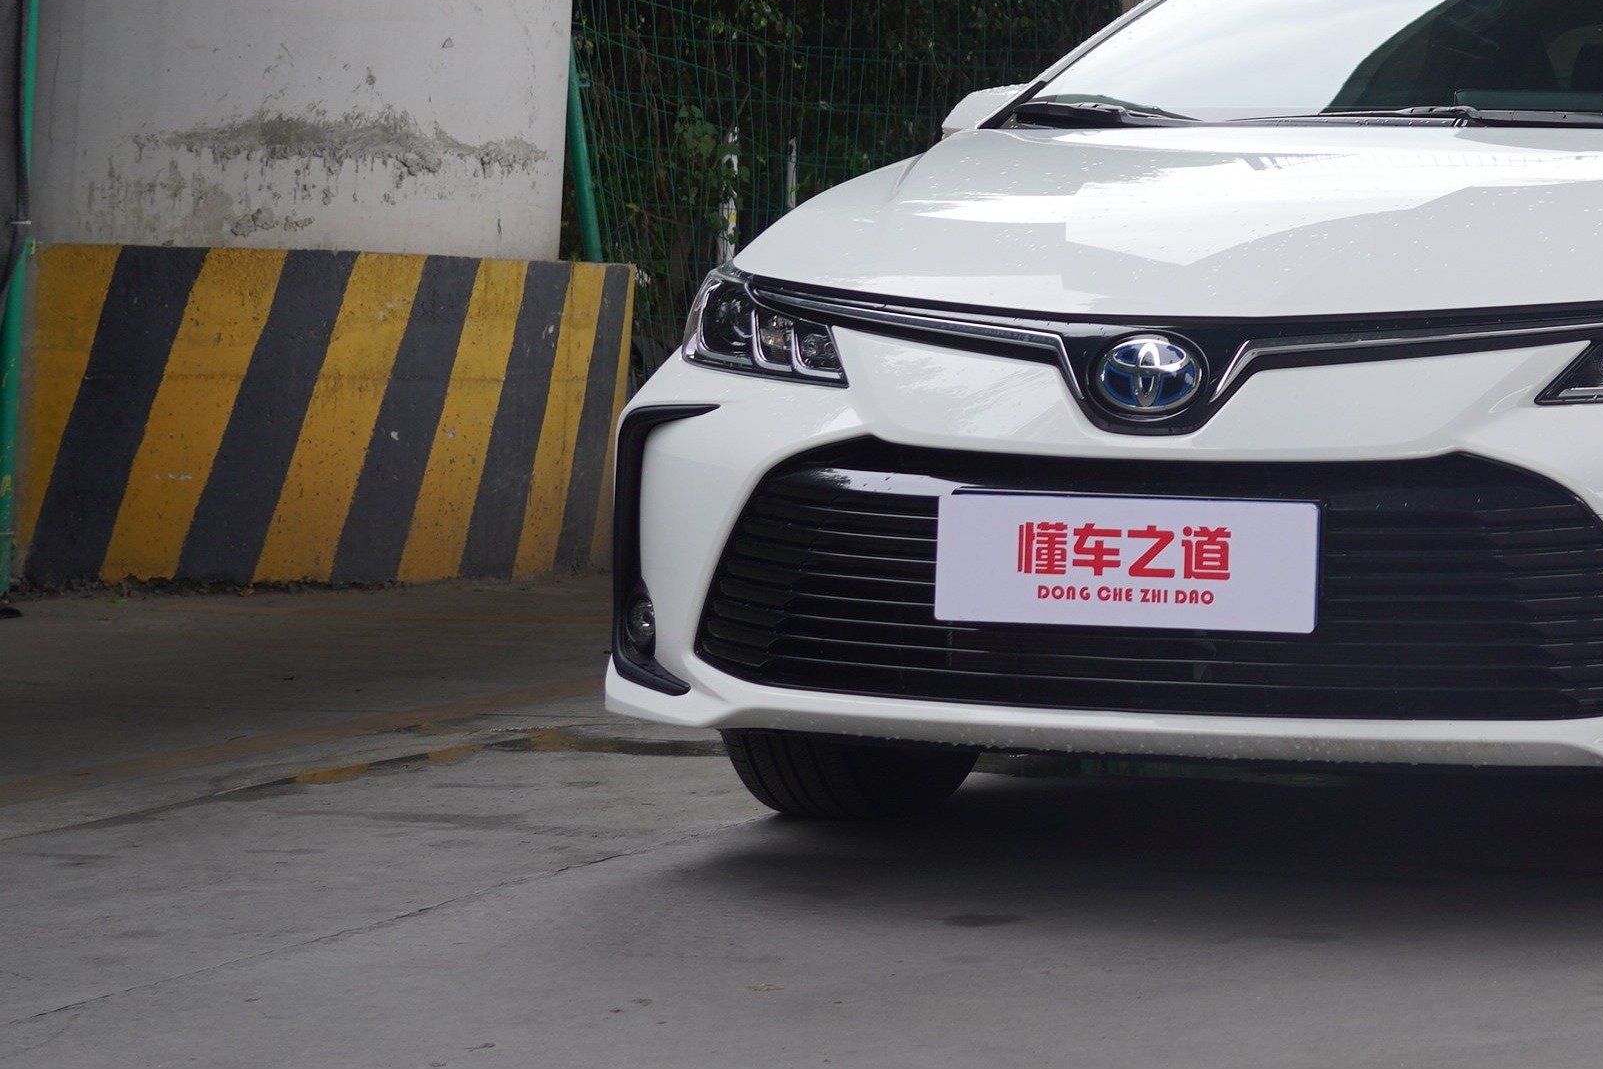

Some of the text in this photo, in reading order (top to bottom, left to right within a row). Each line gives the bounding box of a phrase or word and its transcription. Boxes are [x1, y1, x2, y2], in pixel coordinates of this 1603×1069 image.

[1017, 521, 1232, 581] 懂车之道
[1037, 585, 1214, 605] DONG CHE ZHI DAO
